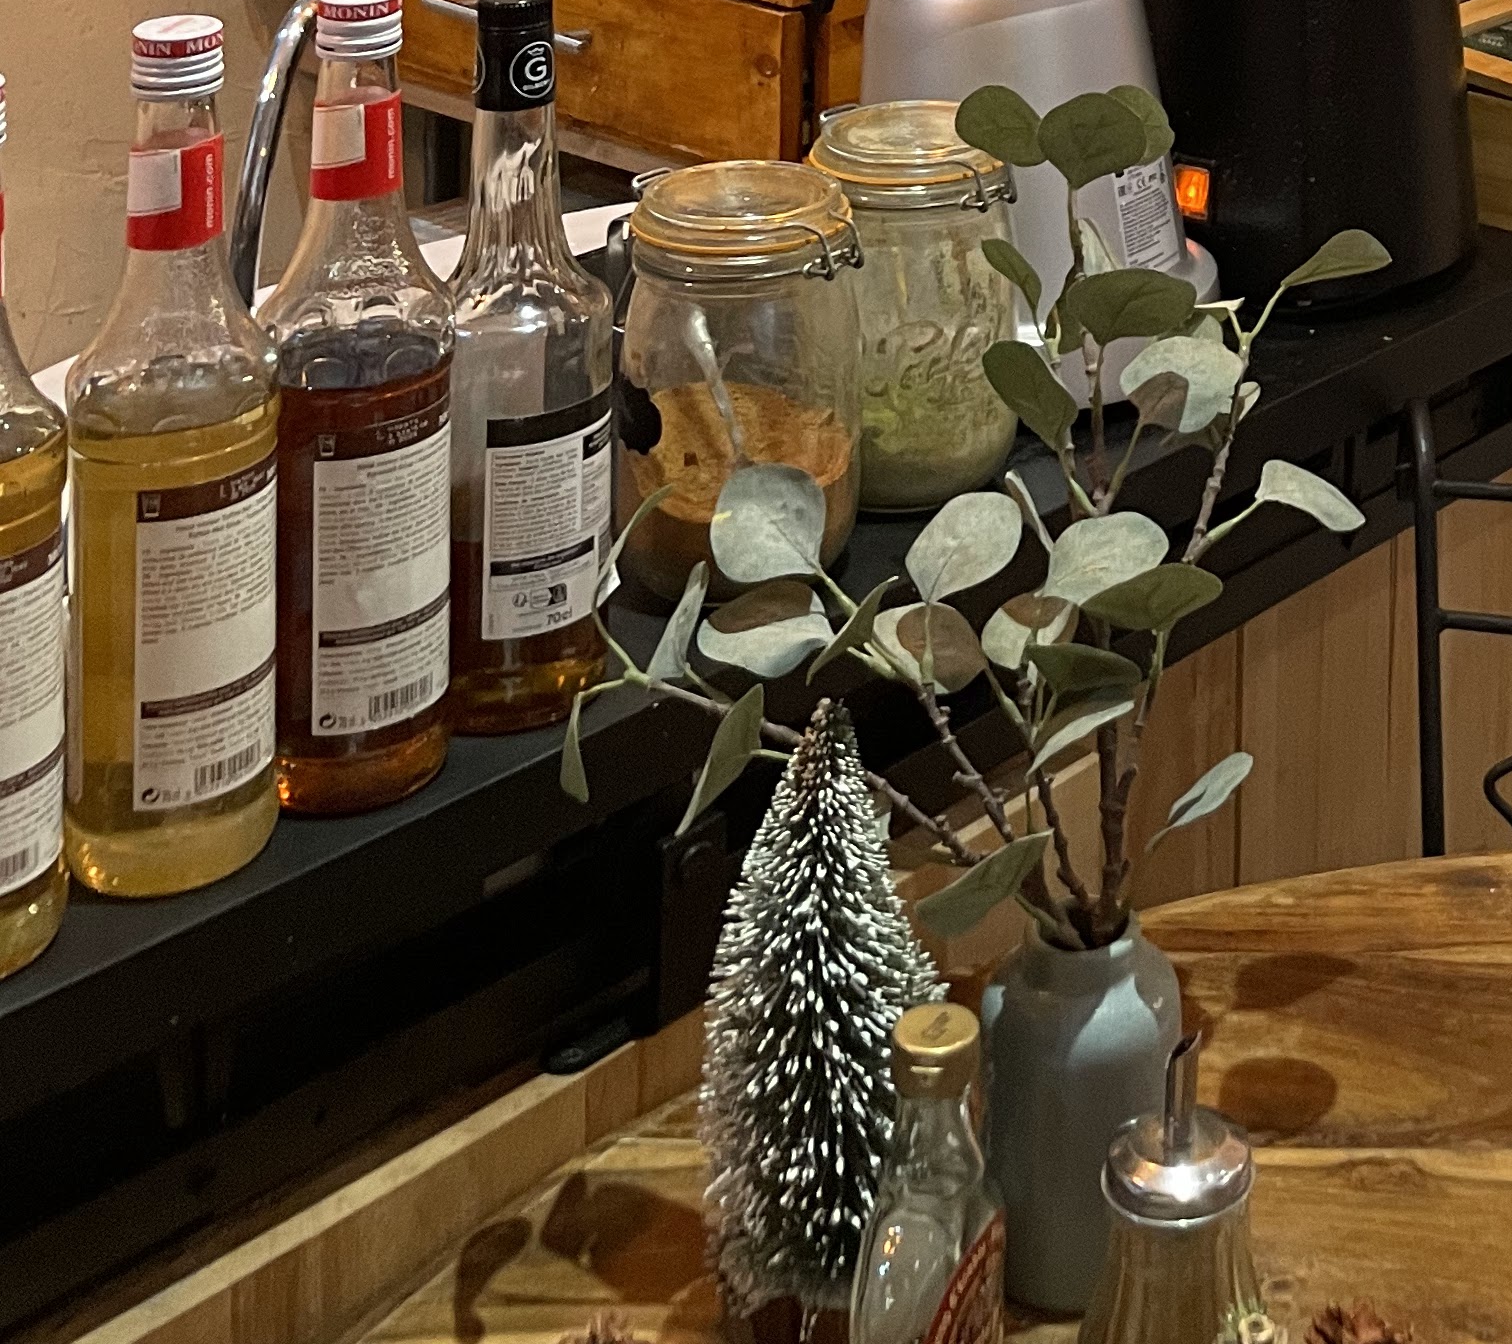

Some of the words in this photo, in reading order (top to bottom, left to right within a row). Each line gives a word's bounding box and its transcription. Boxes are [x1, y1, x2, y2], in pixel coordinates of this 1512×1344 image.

[323, 2, 390, 20] MONIN
[524, 56, 547, 81] G
[387, 107, 396, 180] monin.com
[205, 152, 214, 229] monin.com
